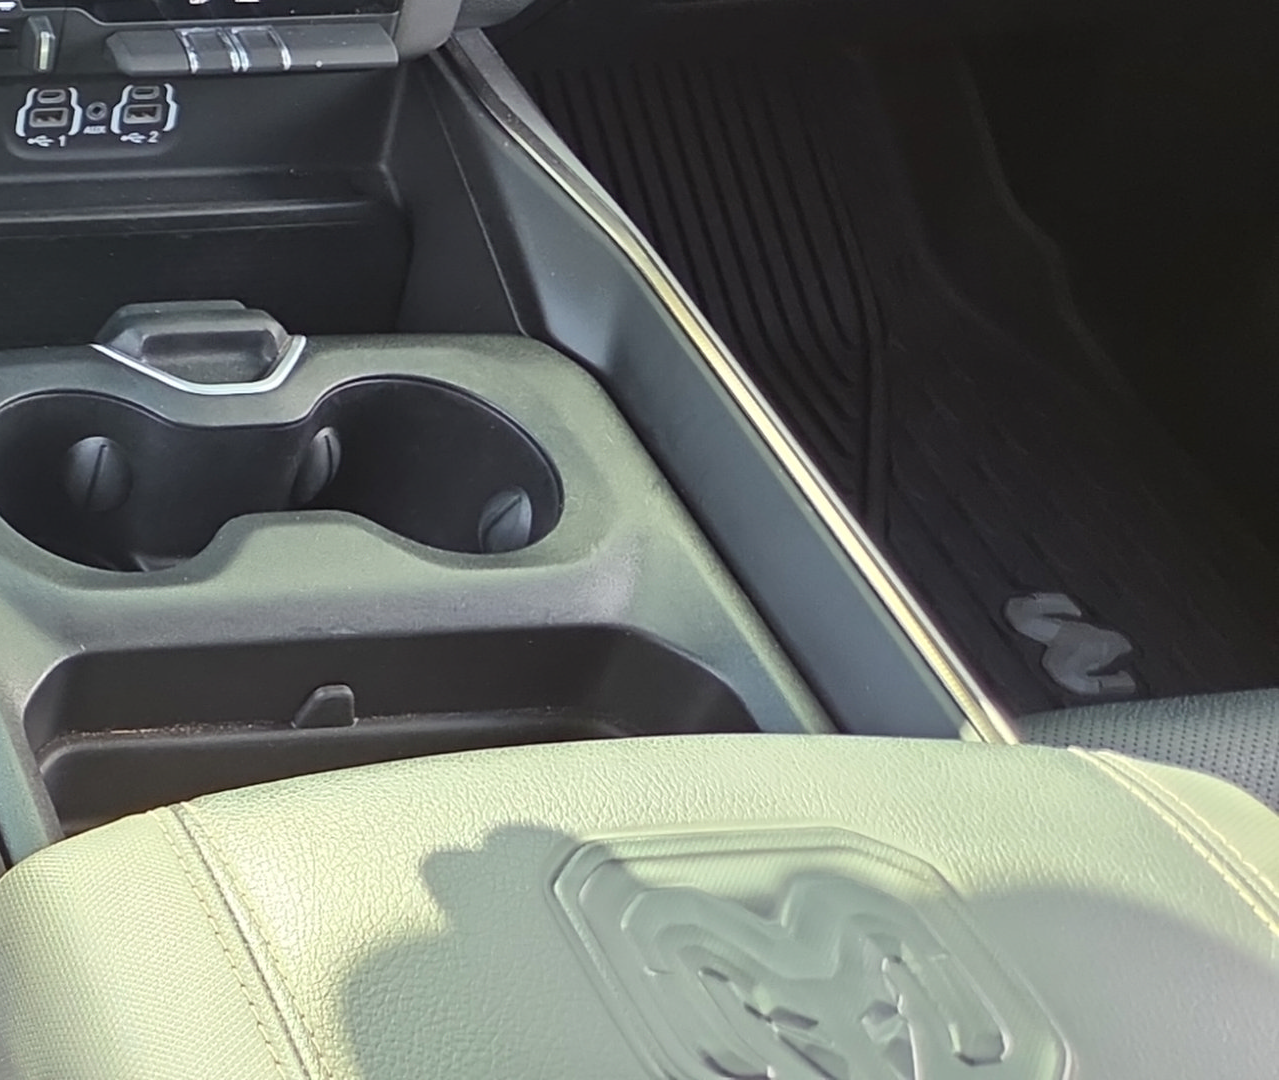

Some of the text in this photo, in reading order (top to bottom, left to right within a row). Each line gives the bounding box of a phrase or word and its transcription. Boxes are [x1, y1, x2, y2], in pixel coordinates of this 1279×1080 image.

[83, 126, 106, 134] AUX
[58, 136, 66, 147] 1
[148, 131, 159, 143] 2
